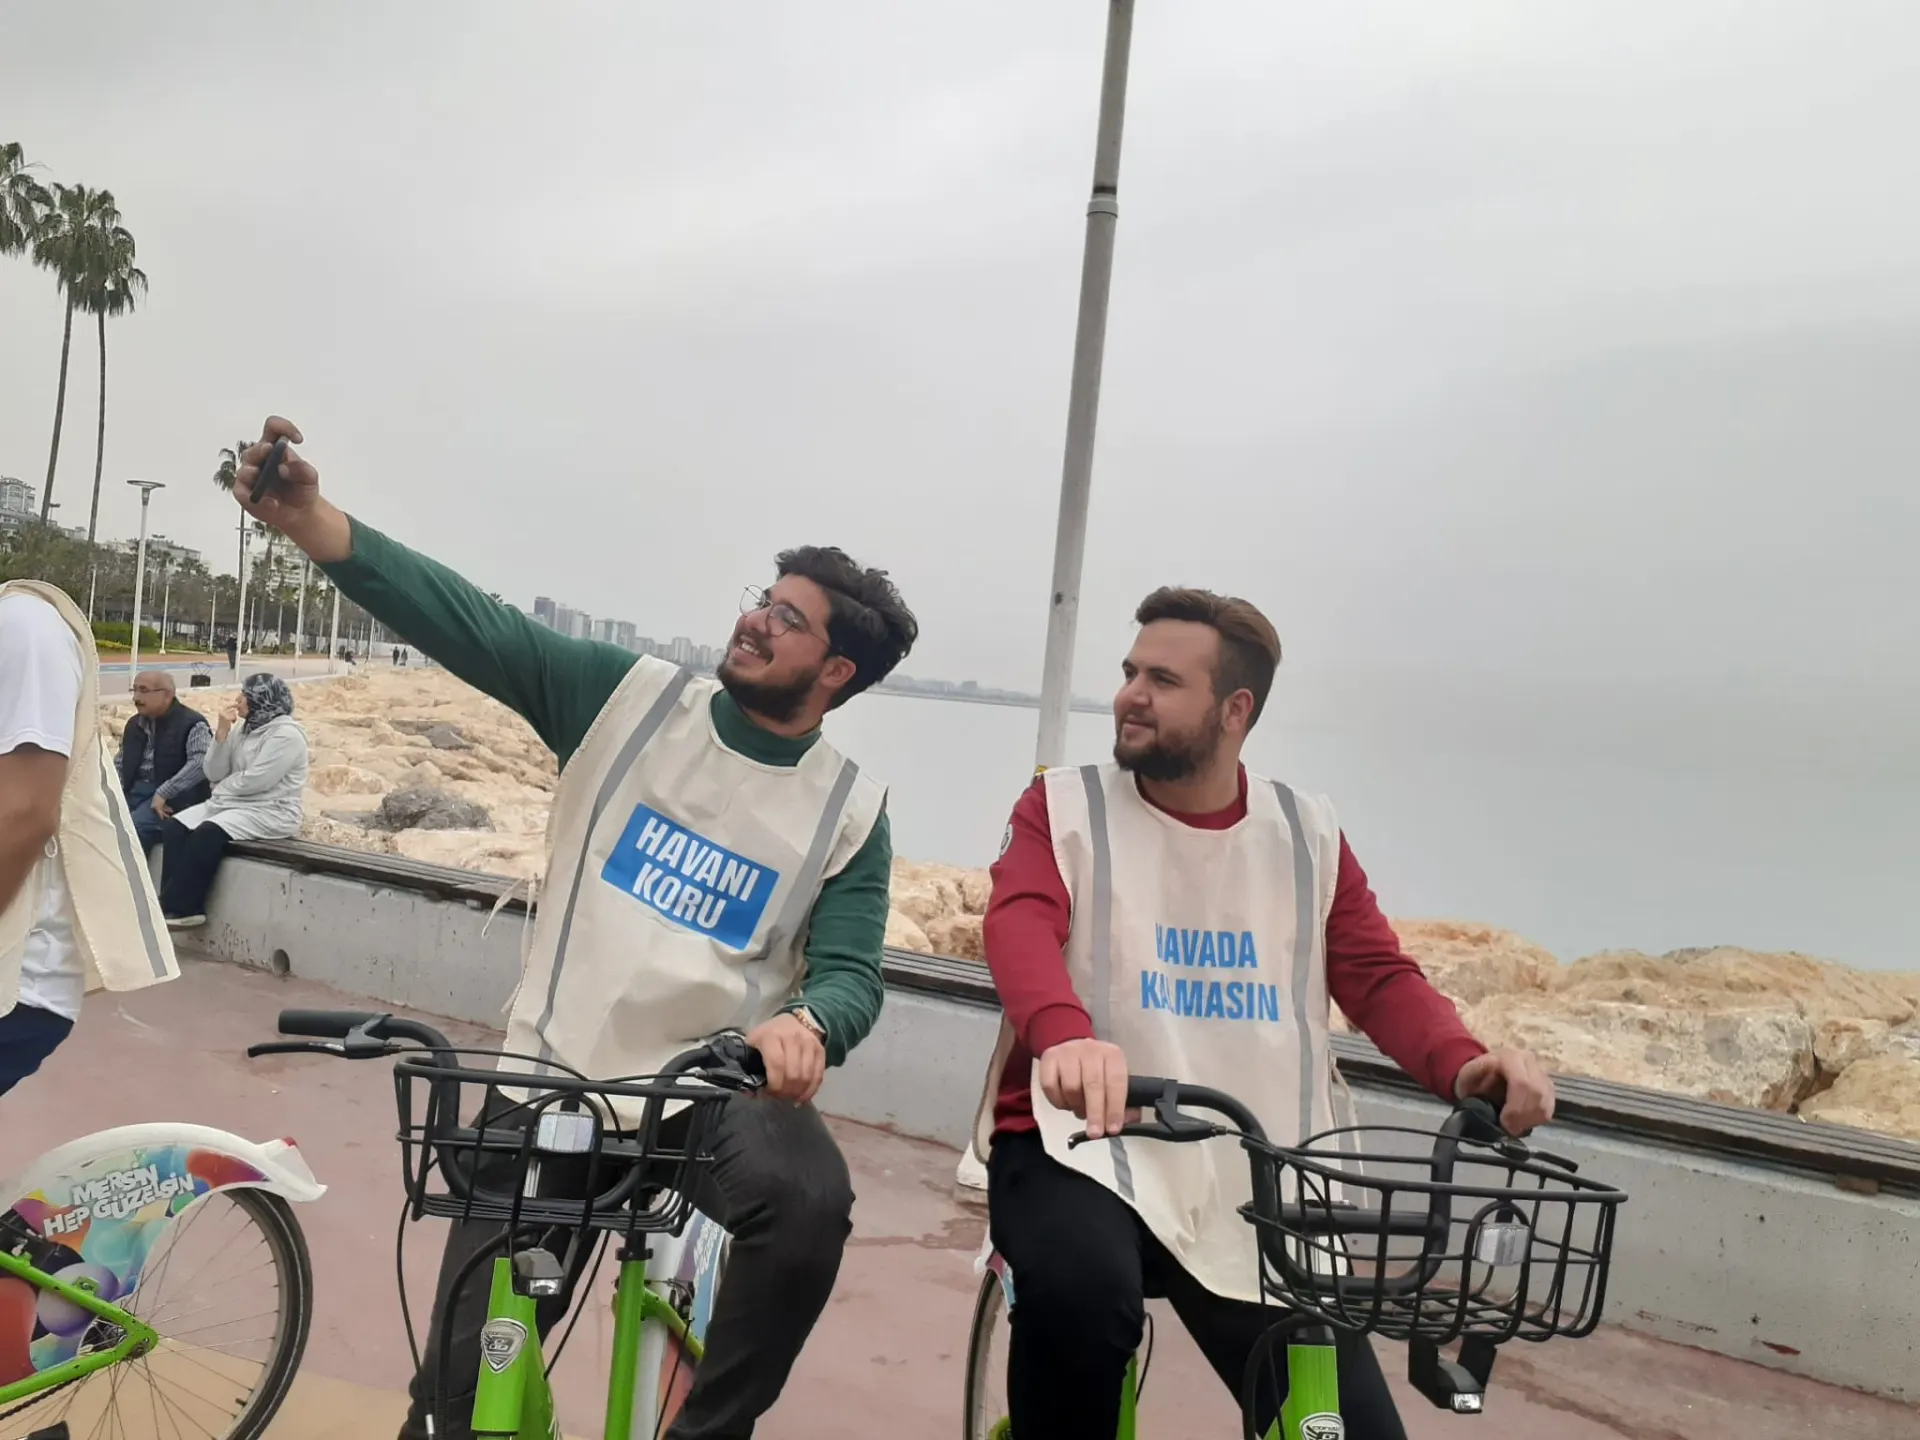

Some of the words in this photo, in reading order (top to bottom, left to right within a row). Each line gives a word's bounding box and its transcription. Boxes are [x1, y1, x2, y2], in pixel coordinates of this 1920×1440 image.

[636, 817, 760, 901] HAVANI
[632, 862, 727, 929] KORU
[1141, 969, 1279, 1021] KAMASIN
[43, 1207, 91, 1237] HEP
